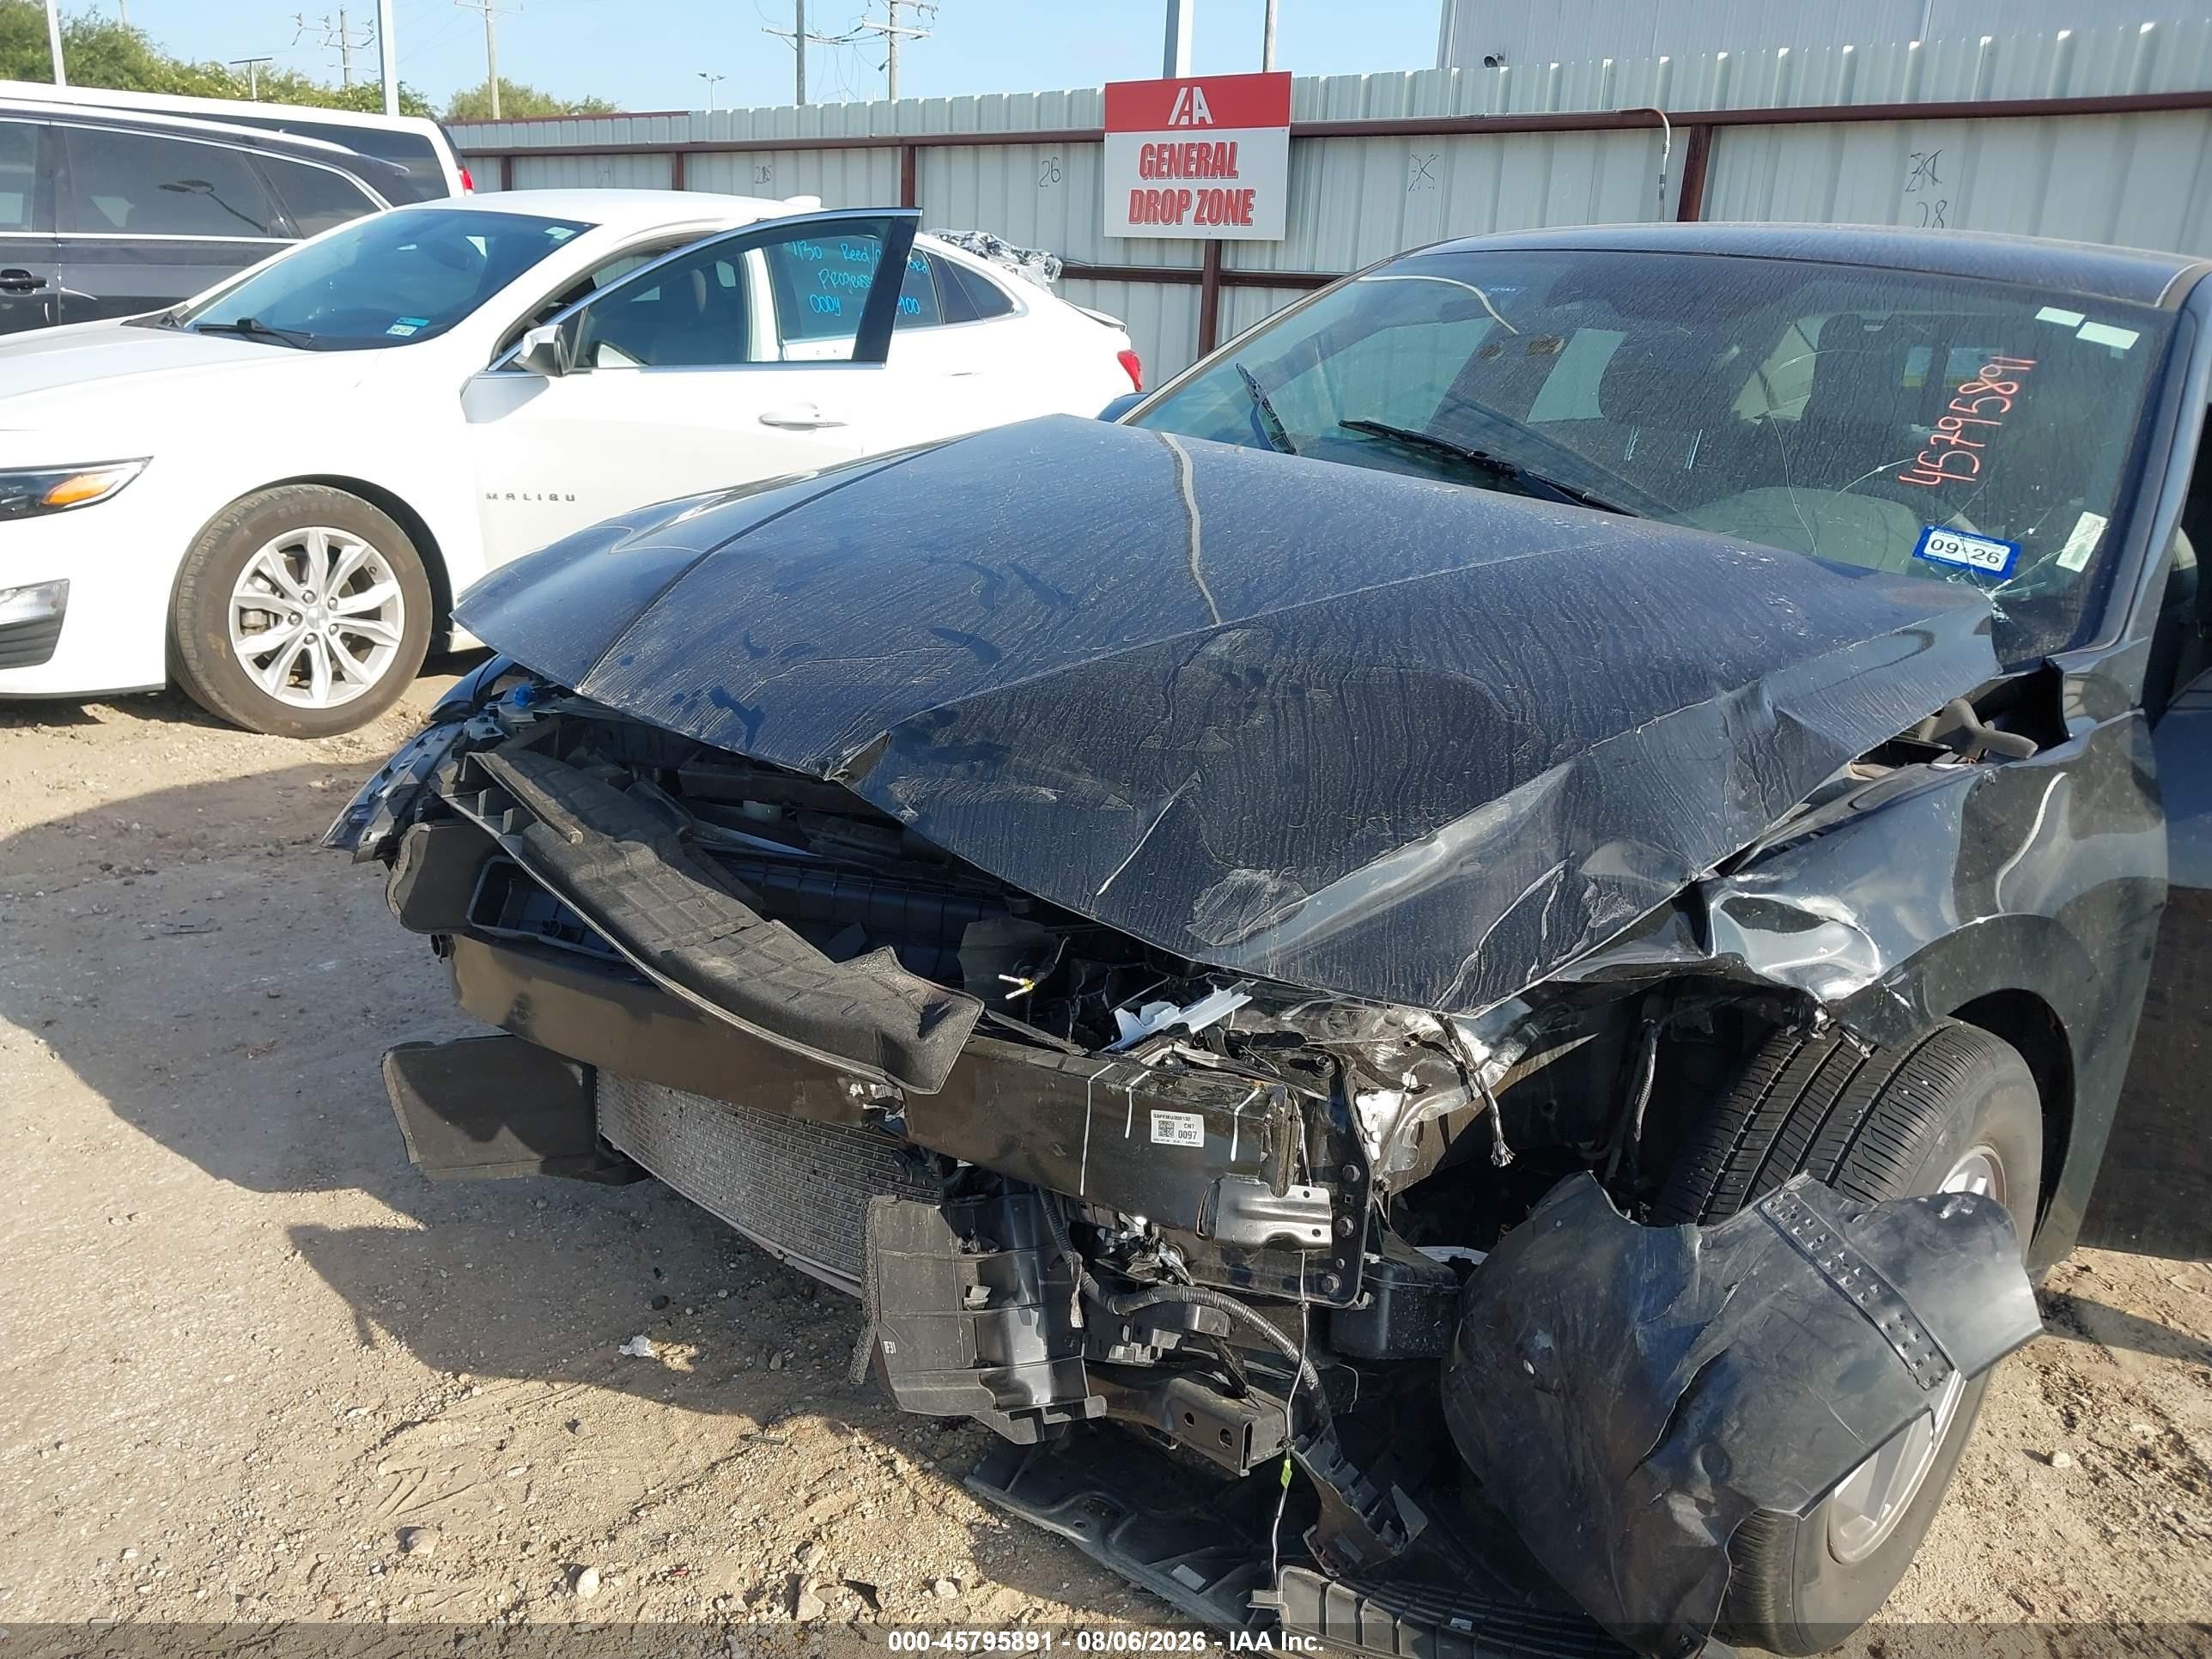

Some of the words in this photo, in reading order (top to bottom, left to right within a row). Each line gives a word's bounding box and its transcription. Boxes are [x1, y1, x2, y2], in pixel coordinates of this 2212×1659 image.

[1039, 156, 1061, 187] 26
[1139, 141, 1239, 180] GENERAL
[1128, 188, 1192, 226] DROP
[1194, 188, 1255, 227] ZONE
[1899, 356, 2037, 485] 45795891
[485, 492, 575, 501] MALIBU
[1178, 1130, 1197, 1139] 0097
